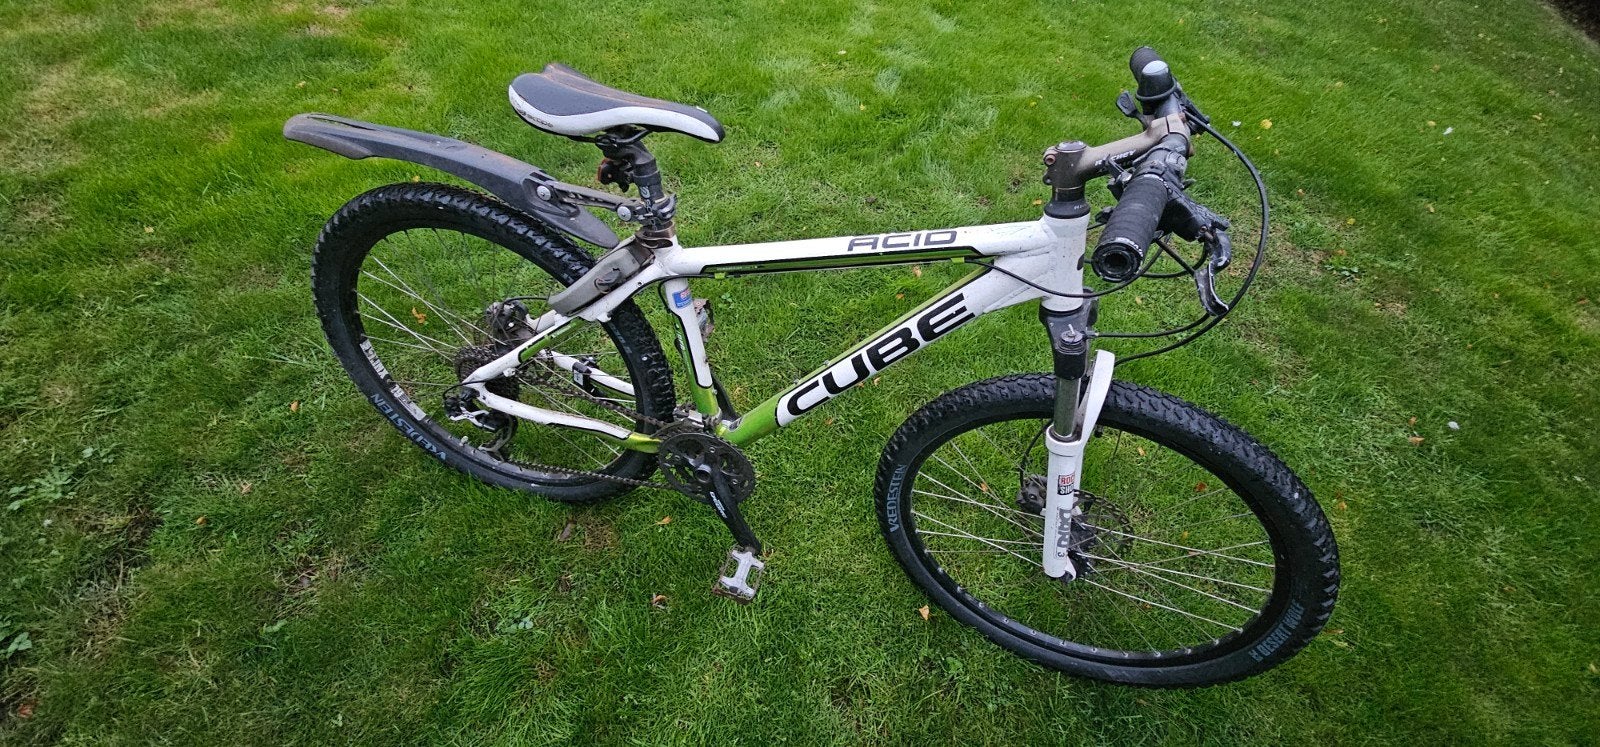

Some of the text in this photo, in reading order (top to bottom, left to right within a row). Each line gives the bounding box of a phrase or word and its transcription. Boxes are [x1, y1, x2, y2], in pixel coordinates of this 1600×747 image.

[847, 230, 958, 252] ACID
[787, 293, 975, 416] CUBE
[886, 463, 908, 533] VREDESTEIN
[1060, 474, 1074, 484] ROC
[1256, 599, 1305, 657] DESERT WOLF
